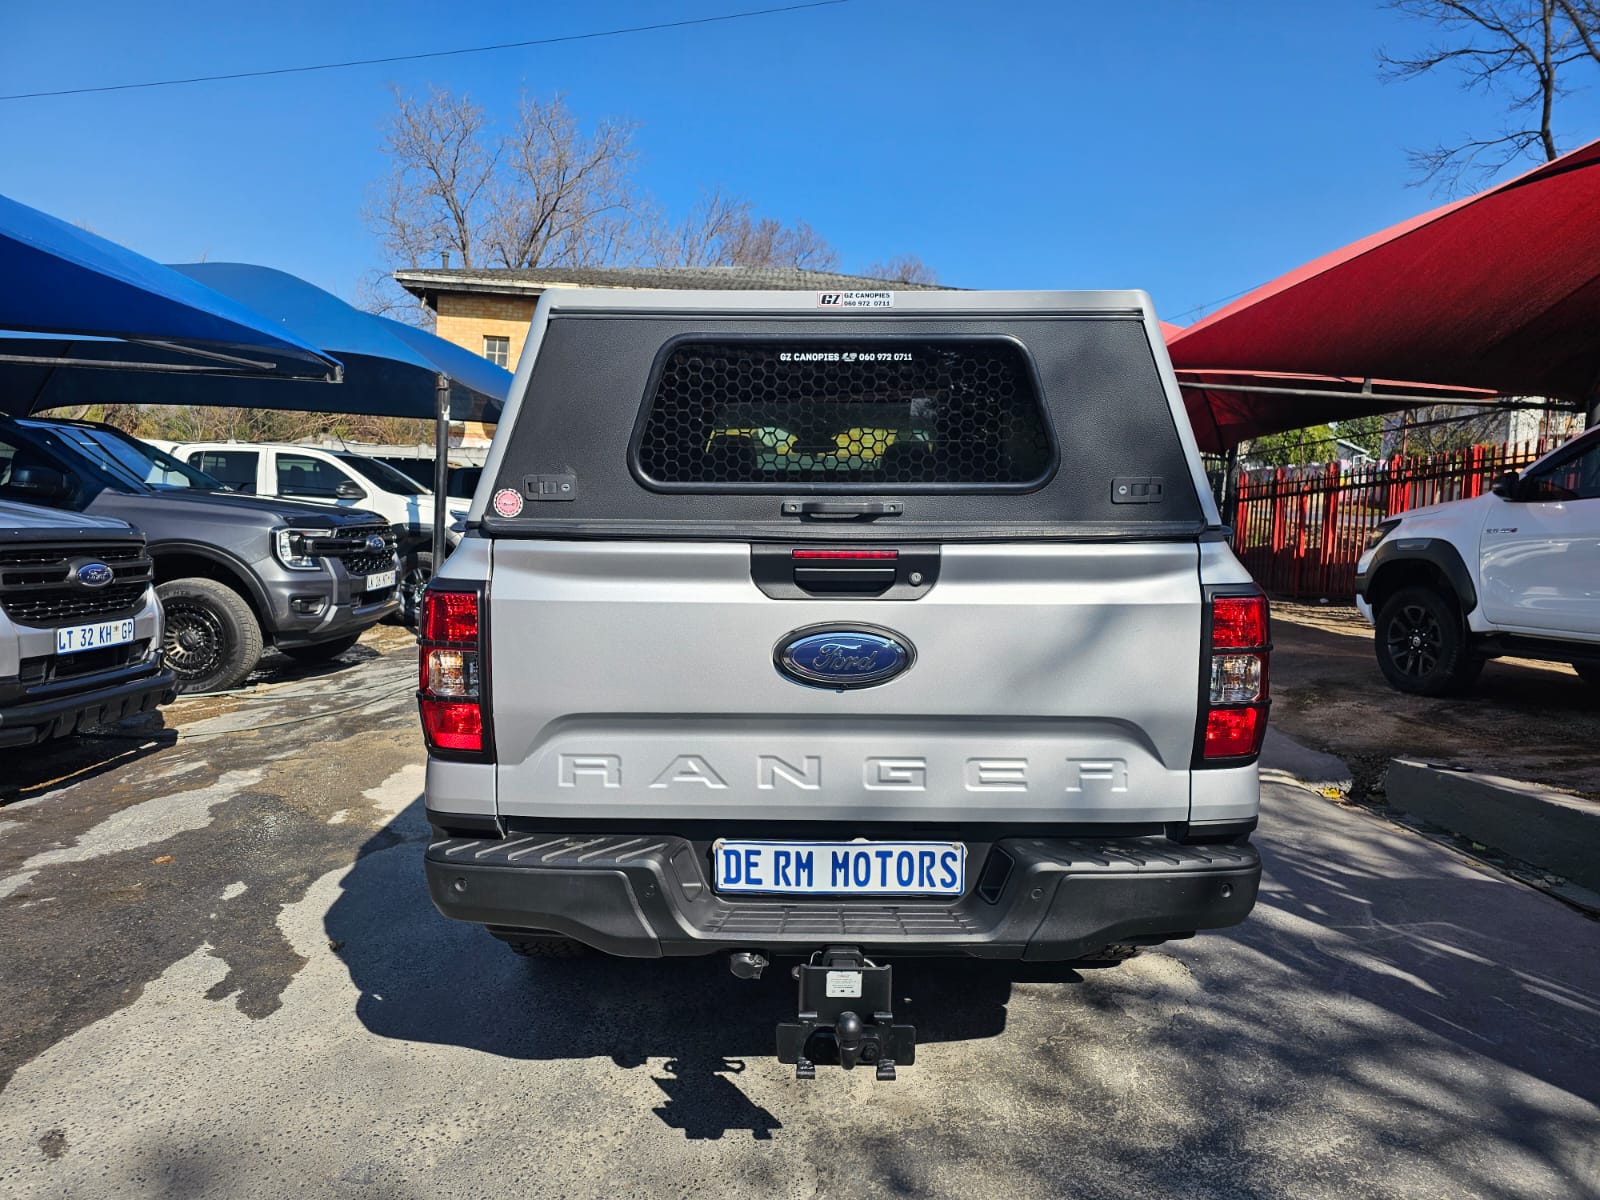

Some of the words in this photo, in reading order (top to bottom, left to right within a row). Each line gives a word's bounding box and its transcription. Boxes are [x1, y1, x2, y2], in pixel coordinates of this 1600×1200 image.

[821, 294, 841, 305] GZ
[780, 352, 792, 361] GZ
[793, 352, 840, 361] CANOPIES
[859, 352, 875, 361] 060
[876, 352, 892, 361] 972
[893, 352, 913, 361] 0711
[58, 630, 74, 650] LT
[80, 628, 94, 647] 32
[99, 625, 112, 644] KH
[121, 621, 133, 640] GP
[812, 643, 878, 671] Ford
[557, 753, 1129, 792] RANGER
[723, 849, 763, 885] DE
[773, 850, 814, 888] RM
[831, 850, 958, 889] MOTORS
